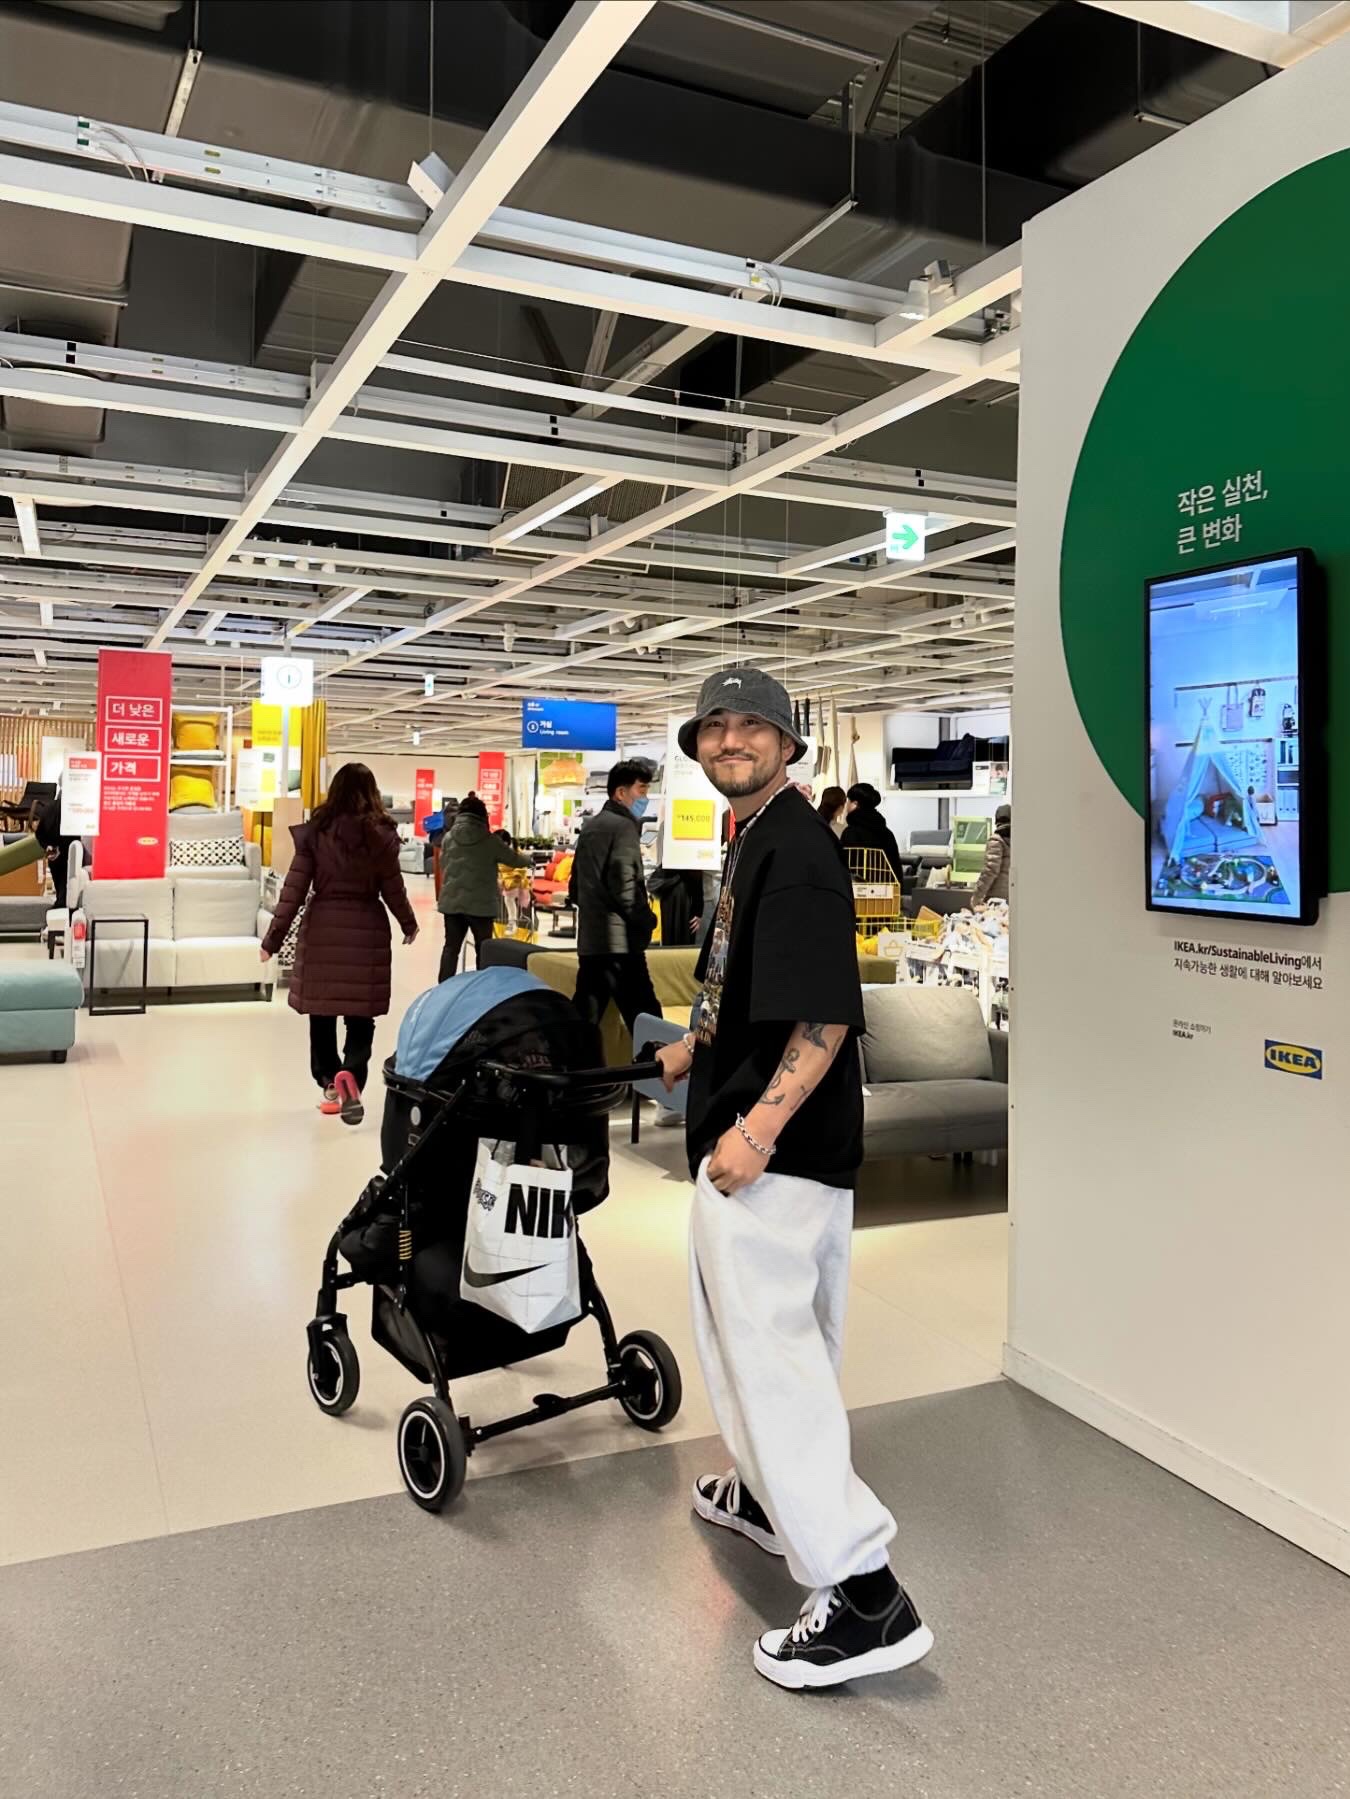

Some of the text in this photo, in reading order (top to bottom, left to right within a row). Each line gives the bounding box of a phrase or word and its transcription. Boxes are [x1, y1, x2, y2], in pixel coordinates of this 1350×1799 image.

[1178, 470, 1268, 516] 작은 실천,
[1177, 513, 1243, 554] 큰 변화
[112, 703, 155, 718] 더 낮은
[112, 732, 150, 747] 새로운
[111, 761, 137, 775] 가격
[1174, 940, 1322, 970] IKEA.kr/SustainableLiving에서
[1174, 958, 1323, 990] 지속가능한 생활에 대해 알아보세요
[1269, 1049, 1318, 1069] IKEA
